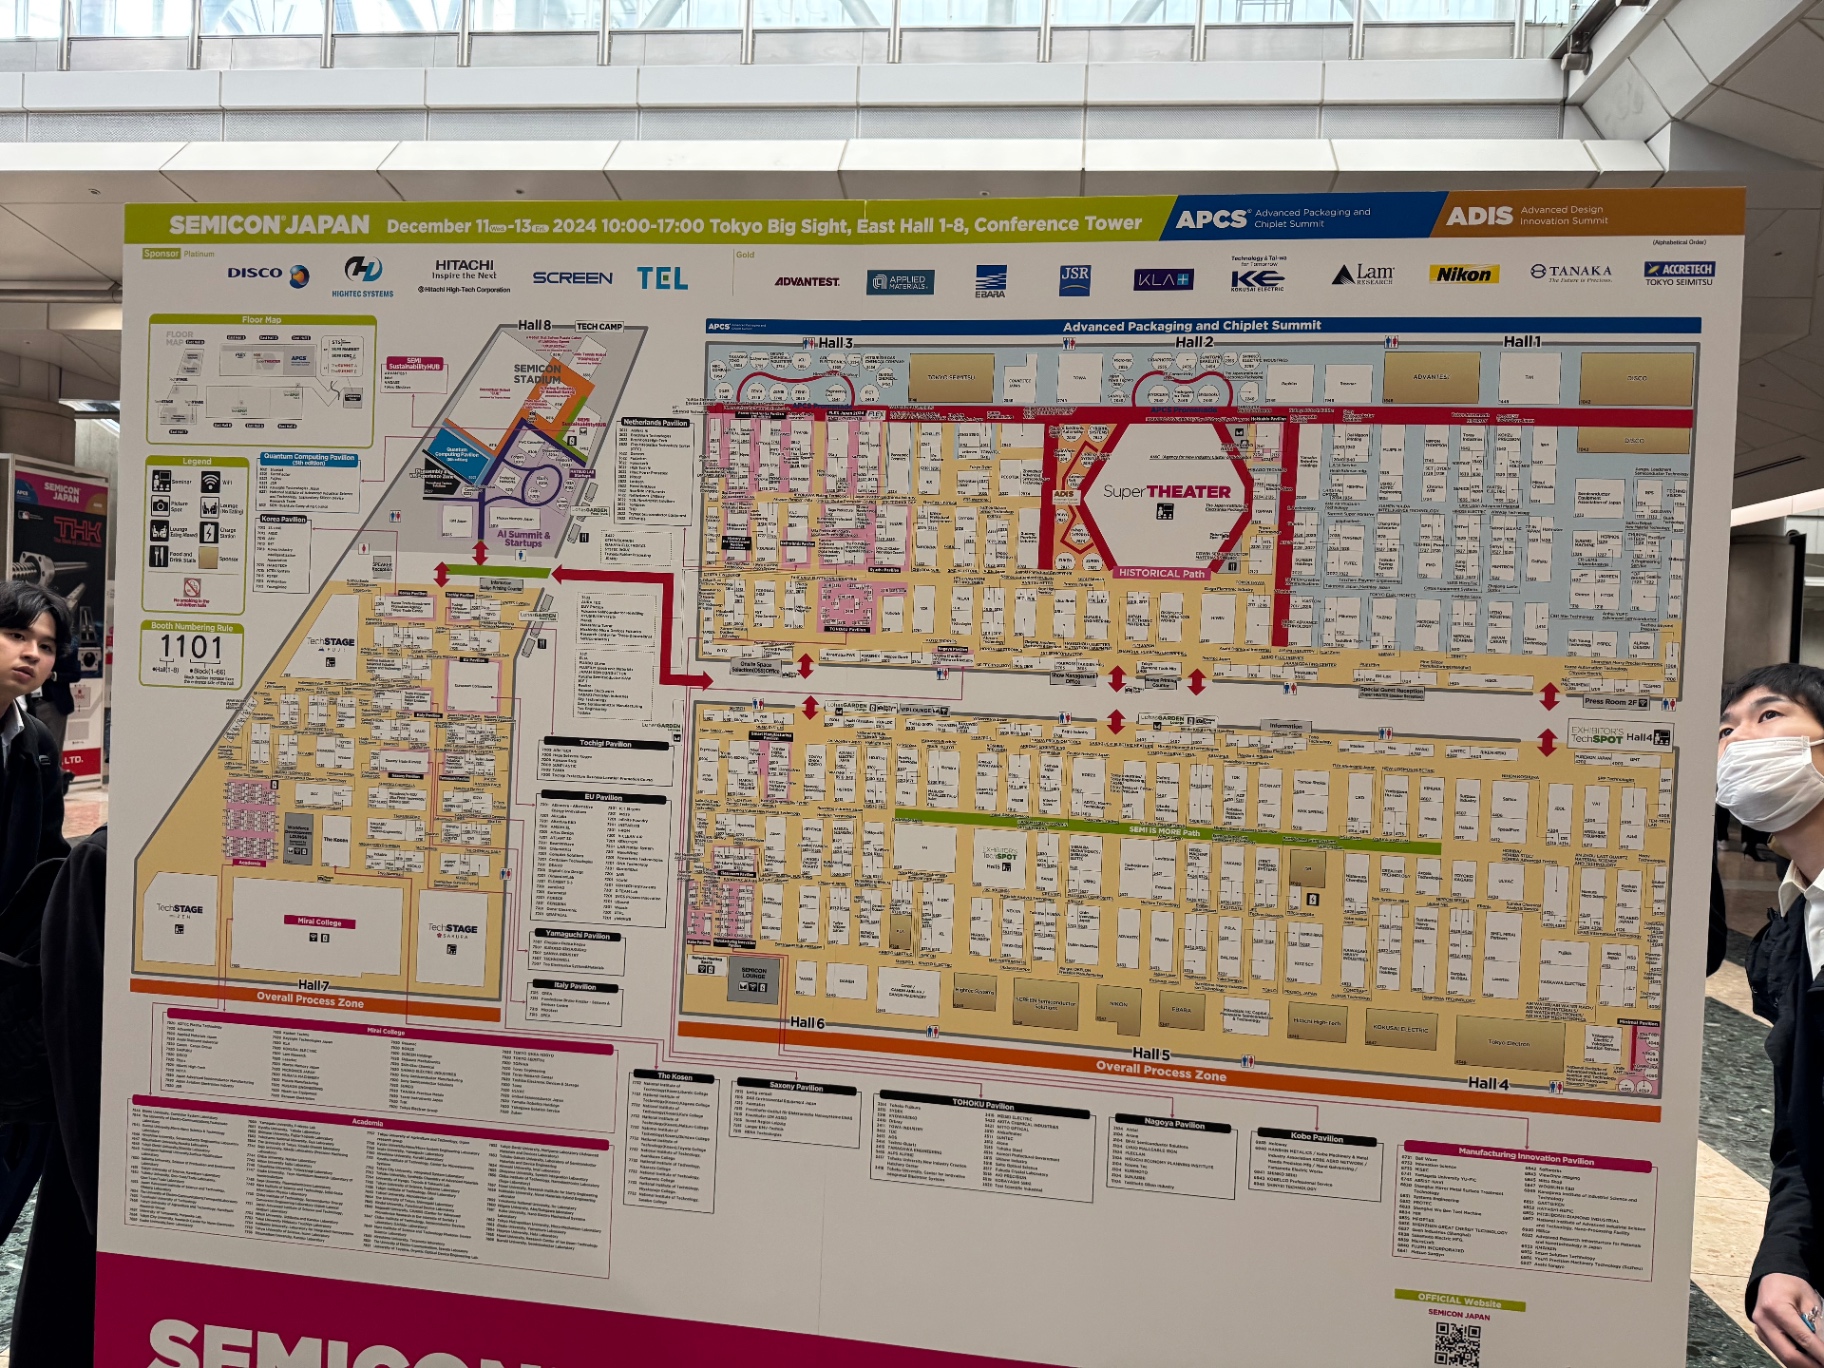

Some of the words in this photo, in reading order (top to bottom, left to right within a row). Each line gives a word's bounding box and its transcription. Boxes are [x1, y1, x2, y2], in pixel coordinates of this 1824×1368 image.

[1255, 209, 1300, 217] Advanced
[1304, 209, 1351, 219] Packaging
[1446, 206, 1513, 225] ADIS
[1521, 206, 1568, 214] Advanced
[1571, 205, 1604, 216] Design
[286, 215, 369, 234] JAPAN
[387, 219, 471, 234] December
[553, 218, 597, 233] 2024
[602, 218, 704, 233] 10:00-17:00
[710, 218, 763, 235] Tokyo
[768, 219, 796, 236] Big
[801, 218, 852, 236] Sight,
[857, 218, 895, 234] East
[900, 217, 933, 233] Hall
[939, 217, 969, 234] 1-8,
[974, 216, 1079, 232] Conference
[1085, 215, 1142, 230] Tower
[1255, 220, 1287, 230] Chiplet
[1290, 220, 1324, 228] Summit
[1520, 217, 1569, 225] Innovation
[1572, 216, 1608, 225] Summit
[144, 249, 179, 259] Sponsor
[435, 259, 494, 271] HITACHI
[1662, 264, 1712, 275] ACCRETECH
[228, 268, 282, 278] DISCO
[432, 271, 461, 281] Inspire
[462, 271, 476, 279] the
[478, 271, 497, 279] Next
[1062, 267, 1089, 279] JSR
[1357, 263, 1393, 279] Lam
[1437, 267, 1492, 281] Nikon
[1549, 266, 1612, 276] TANAKA
[533, 271, 613, 284] SCREEN
[637, 266, 689, 290] TEL
[890, 275, 926, 283] APPLIED
[1139, 273, 1175, 286] KLA
[424, 286, 445, 294] Hitachi
[445, 286, 476, 294] High-Tech
[476, 286, 510, 294] Corporation
[975, 290, 1005, 298] EBARA
[264, 316, 282, 324] Map
[518, 320, 542, 330] Hall
[544, 320, 552, 331] 8
[577, 323, 598, 331] TECH
[599, 323, 622, 331] CAMP
[1063, 322, 1125, 332] Advanced
[1128, 321, 1193, 332] Packaging
[1196, 321, 1220, 331] and
[1223, 321, 1268, 332] Chiplet
[1272, 320, 1322, 331] Summit
[819, 337, 844, 349] Hall
[845, 338, 853, 349] 3
[1176, 336, 1203, 348] Hall
[1205, 337, 1214, 348] 2
[1504, 336, 1533, 348] Hall
[1534, 336, 1541, 348] 1
[514, 364, 561, 374] SEMICON
[514, 375, 561, 384] STADIUM
[183, 457, 212, 466] Legend
[263, 452, 292, 460] Quantum
[294, 453, 328, 461] Computing
[44, 482, 80, 495] SEMICON
[1104, 484, 1231, 500] SuperTHEATER
[53, 493, 80, 503] JAPAN
[279, 516, 306, 524] Pavilion
[54, 517, 102, 541] THK
[497, 530, 506, 539] AI
[507, 530, 539, 540] Summit
[543, 531, 551, 539] &
[505, 538, 542, 548] Startups
[1119, 568, 1173, 578] HISTORICAL
[1177, 569, 1205, 579] Path
[151, 622, 173, 630] Booth
[175, 622, 210, 632] Numbering
[213, 624, 233, 632] Rule
[161, 634, 221, 658] 1101
[307, 637, 355, 647] TechSTAGE
[1605, 698, 1626, 706] Room
[1572, 727, 1624, 735] EXHIBITOR'S
[1571, 734, 1623, 744] TechSPOT
[1626, 732, 1653, 743] Hall4
[580, 740, 603, 748] Tochigi
[605, 740, 632, 748] Pavilion
[64, 756, 84, 764] LTD.
[595, 794, 623, 802] Pavilion
[1129, 825, 1147, 833] SEMI
[1158, 827, 1182, 835] MORE
[1183, 829, 1201, 837] Path
[156, 903, 203, 913] TechSTAGE
[298, 917, 317, 925] Mirai
[319, 918, 341, 927] College
[428, 923, 478, 934] TechSTAGE
[546, 929, 582, 940] Yamaguchi
[584, 932, 610, 940] Pavilion
[298, 980, 322, 991] Hall
[323, 980, 329, 991] 7
[554, 982, 568, 990] Italy
[570, 983, 597, 991] Pavilion
[256, 992, 294, 1004] Overall
[295, 995, 334, 1006] Process
[337, 998, 364, 1009] Zone
[790, 1017, 816, 1029] Hall
[816, 1018, 825, 1029] 6
[1133, 1047, 1161, 1060] Hall
[1163, 1050, 1170, 1061] 5
[1096, 1060, 1141, 1075] Overall
[1143, 1064, 1192, 1079] Process
[1195, 1069, 1227, 1082] Zone
[671, 1074, 693, 1082] Kosen
[1468, 1076, 1497, 1090] Hall
[1498, 1079, 1510, 1090] 4
[769, 1081, 794, 1091] Saxony
[796, 1084, 824, 1092] Pavilion
[953, 1098, 984, 1108] TOHOKU
[985, 1102, 1015, 1110] Pavilion
[352, 1118, 384, 1127] Academia
[1144, 1117, 1173, 1128] Nagoya
[1175, 1120, 1206, 1130] Pavilion
[1291, 1132, 1312, 1141] Kobe
[1314, 1134, 1344, 1144] Pavilion
[1459, 1147, 1515, 1160] Manufacturing
[1518, 1152, 1560, 1163] Innovation
[1562, 1156, 1595, 1166] Pavilion
[1418, 1293, 1461, 1305] OFFICIAL
[1463, 1297, 1502, 1308] Website
[1428, 1308, 1463, 1318] SEMICON
[1465, 1312, 1490, 1321] JAPAN
